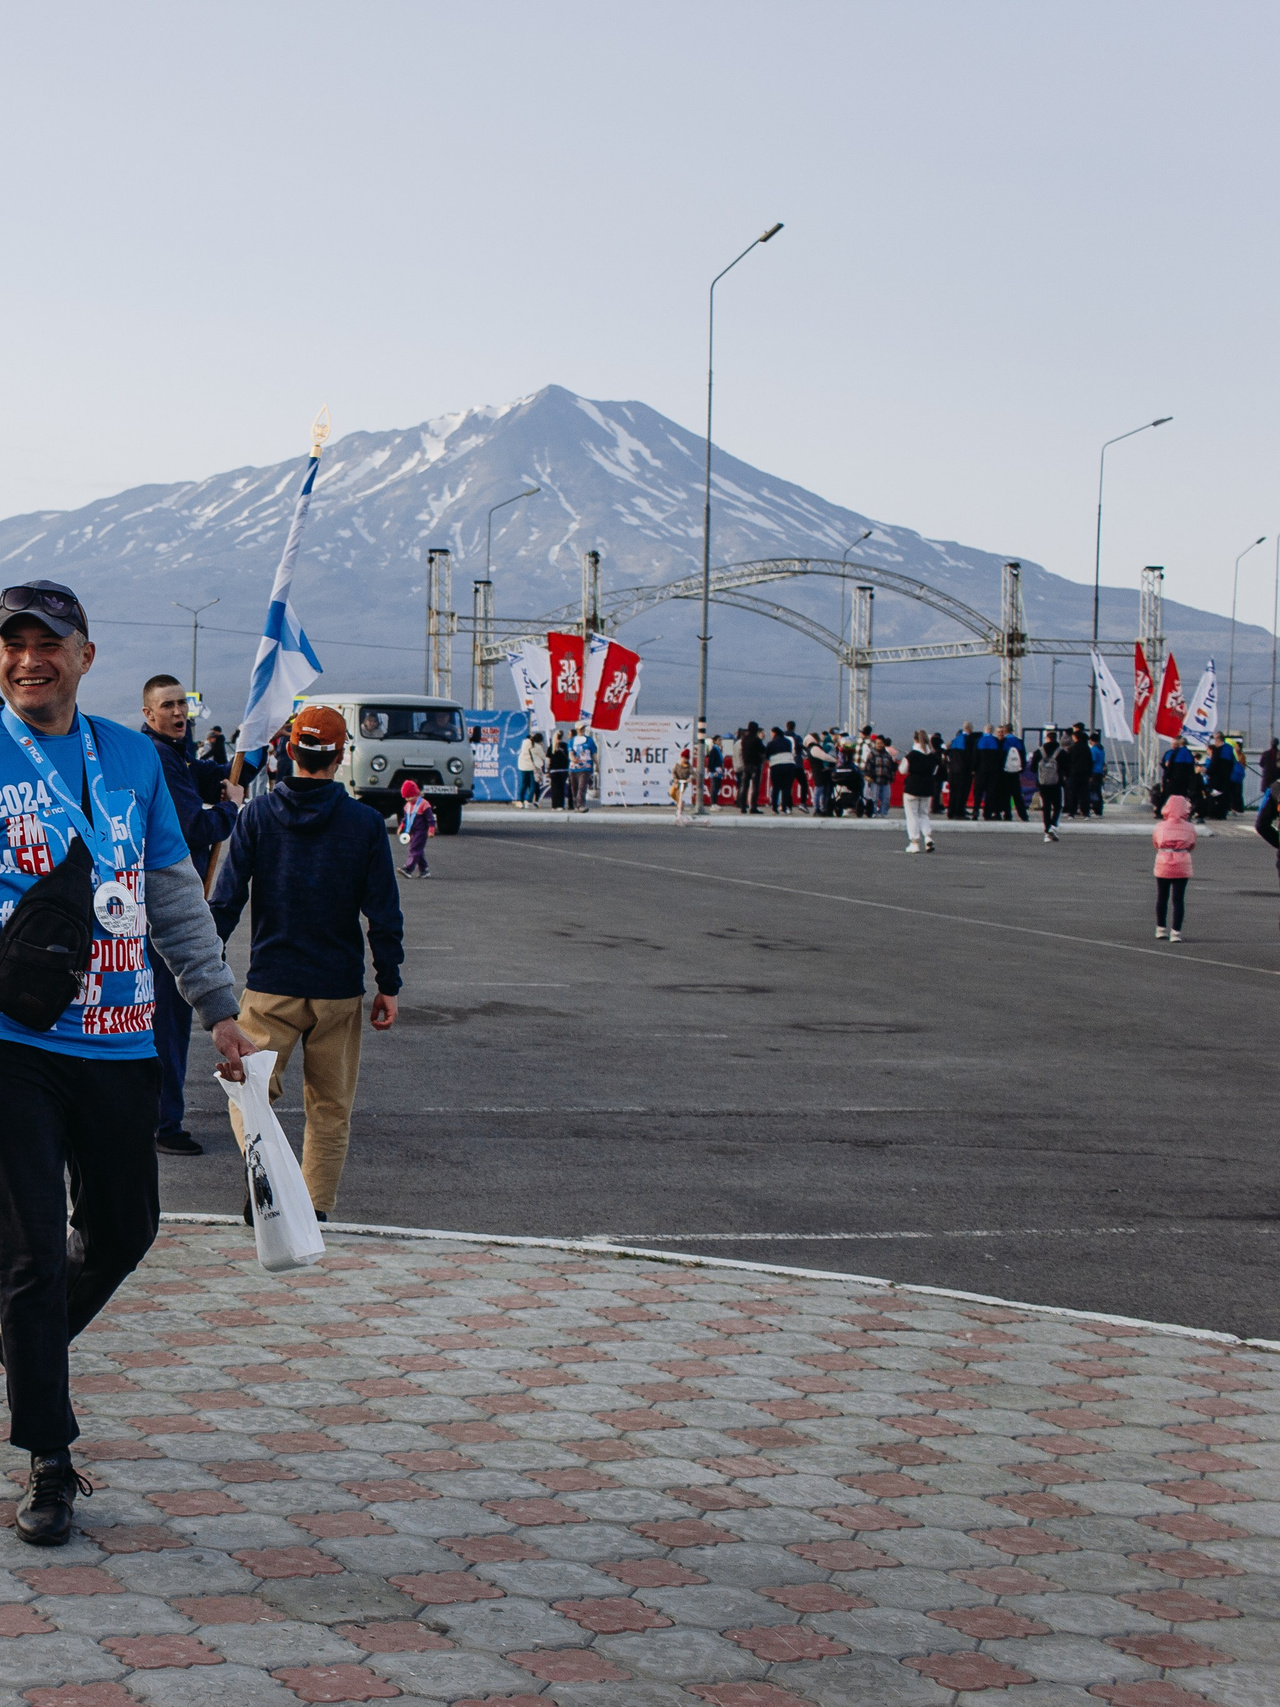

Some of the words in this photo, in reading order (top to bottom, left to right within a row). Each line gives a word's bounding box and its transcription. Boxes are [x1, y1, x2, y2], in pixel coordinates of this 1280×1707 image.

[27, 745, 45, 764] ПСБ
[625, 747, 642, 764] ЗА
[646, 747, 669, 764] БЕГ
[51, 806, 65, 814] ПС
